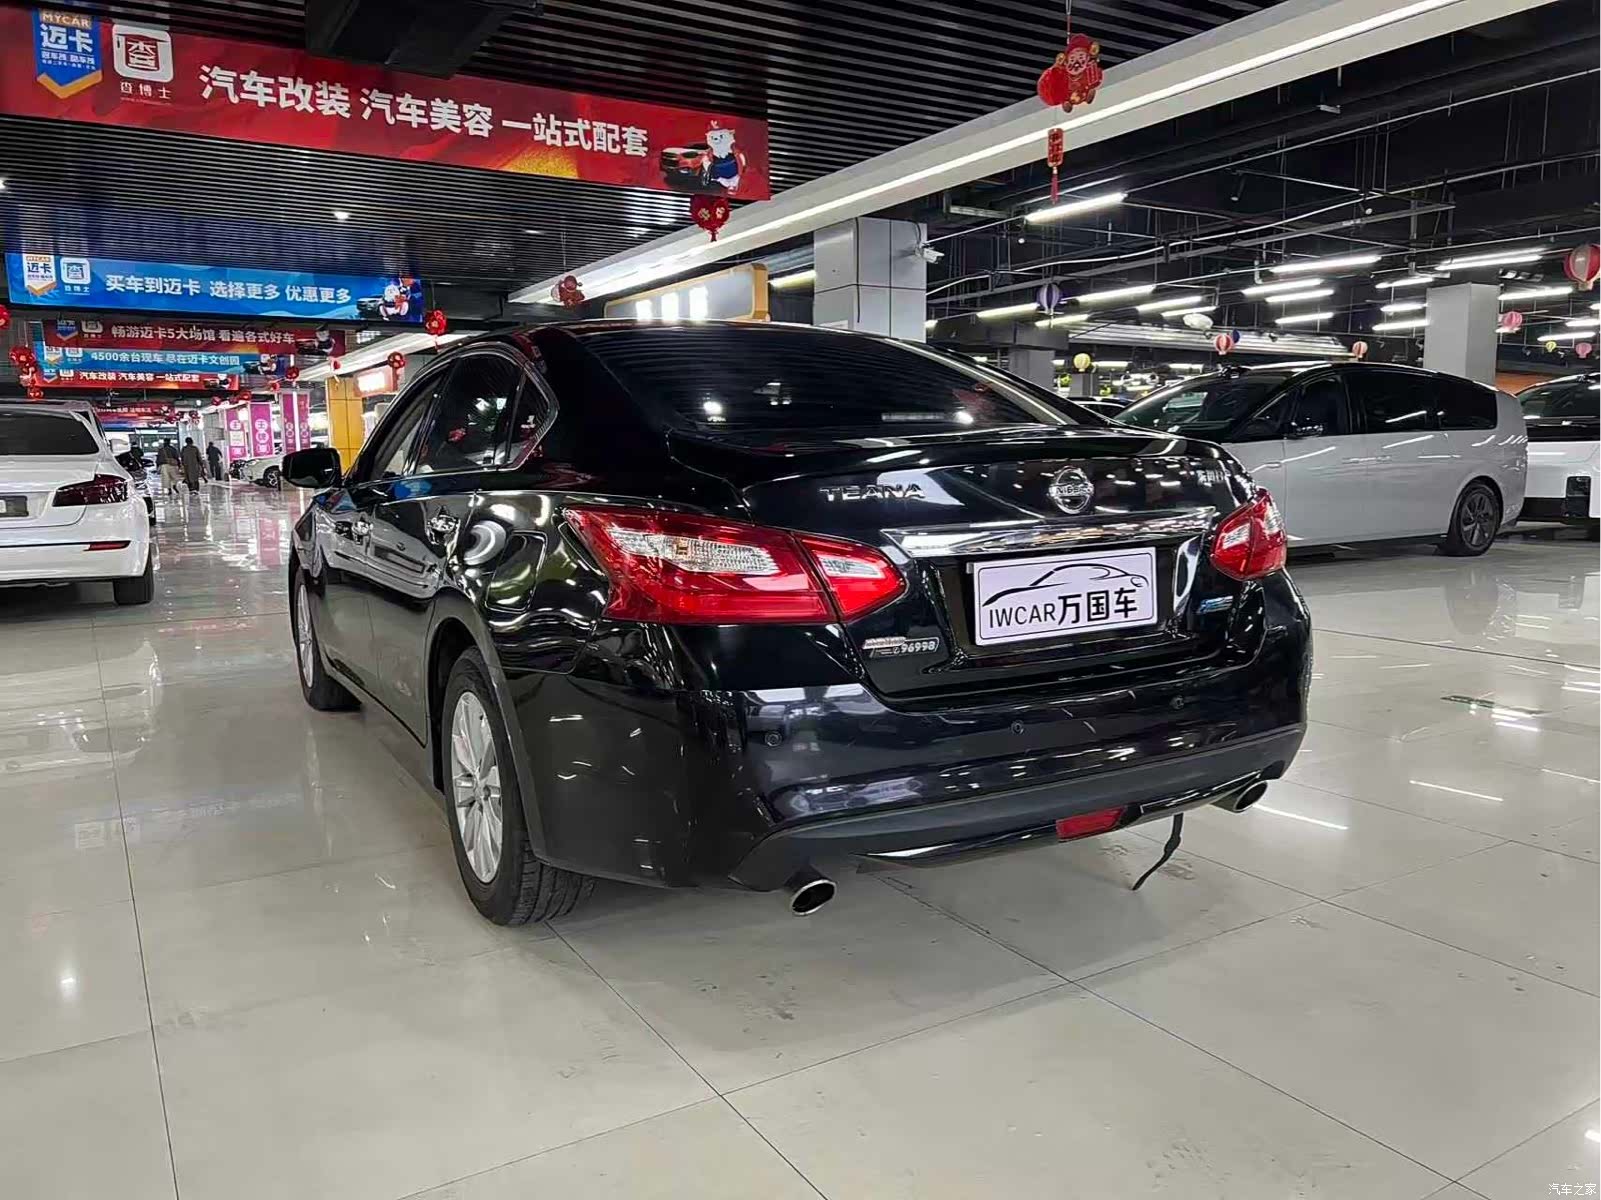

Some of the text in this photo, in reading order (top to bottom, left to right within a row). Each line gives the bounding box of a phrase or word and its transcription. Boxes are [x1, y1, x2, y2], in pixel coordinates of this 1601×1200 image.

[42, 11, 90, 28] MYCAR
[40, 23, 93, 52] 迈卡
[199, 65, 649, 157] 汽车改装 汽车美容 一站式配套
[27, 262, 52, 274] 迈卡
[105, 274, 352, 304] 买车到迈卡 选择更多 优惠更多
[111, 325, 296, 344] 畅游迈卡5大场馆 看遍各式好车
[91, 352, 164, 363] 4500余台现车
[79, 371, 116, 381] 汽车改装
[819, 484, 926, 502] TEANA
[990, 587, 1138, 629] IWCAR万国车
